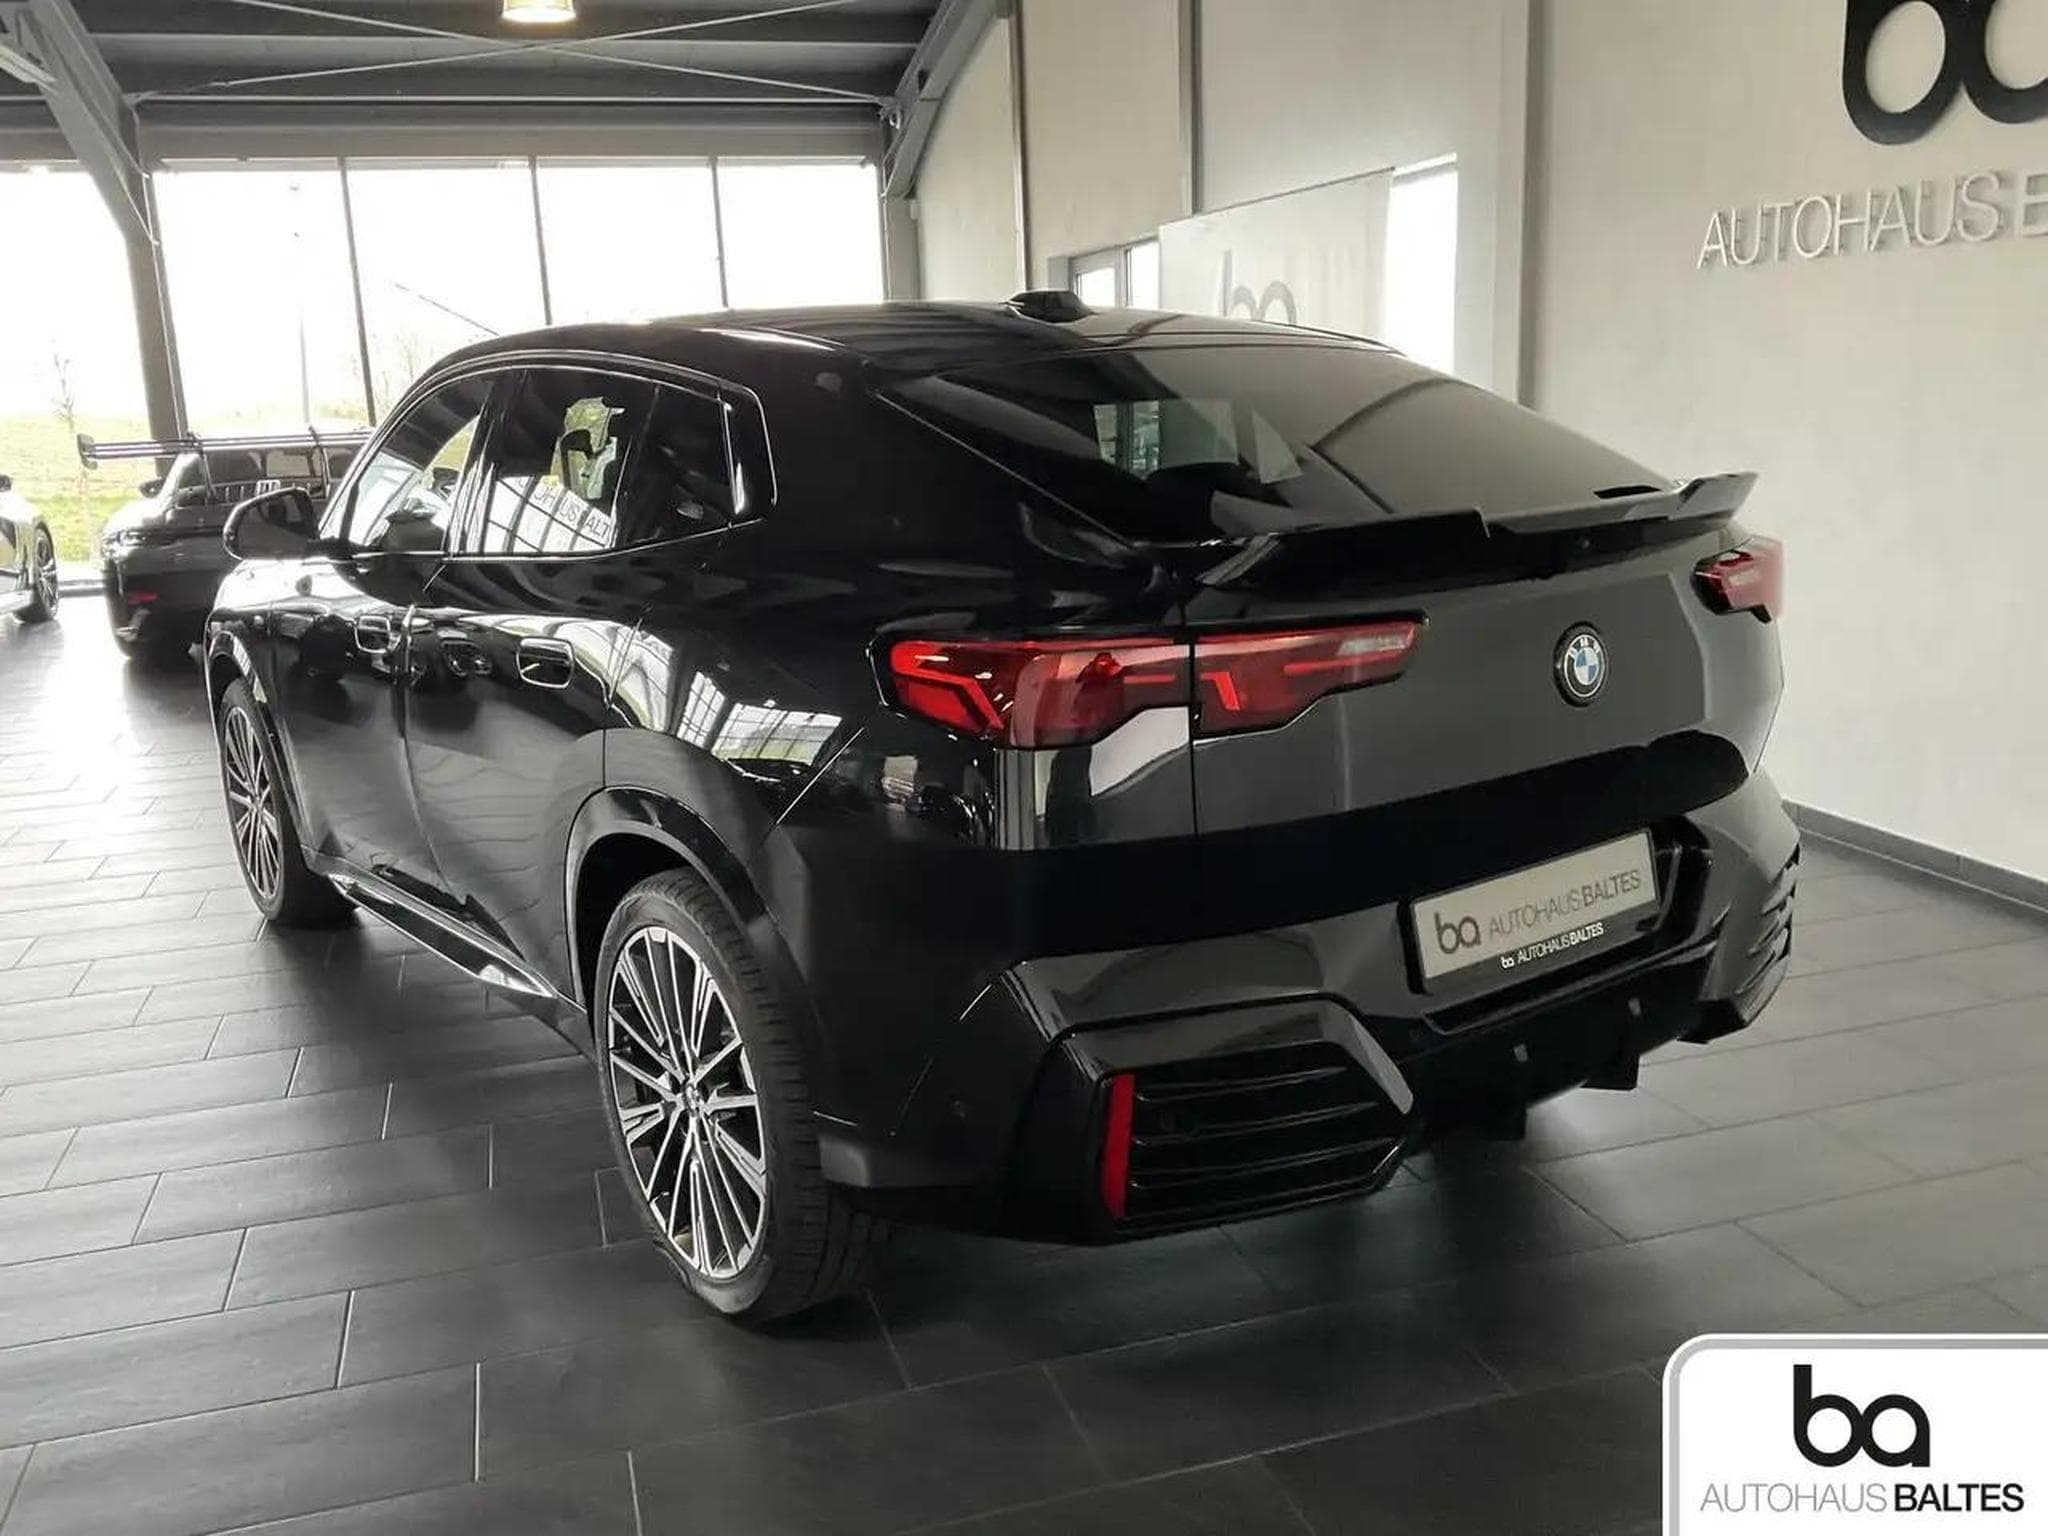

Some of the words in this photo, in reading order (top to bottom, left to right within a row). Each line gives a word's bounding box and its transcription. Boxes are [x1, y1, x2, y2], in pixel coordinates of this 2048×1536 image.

[1697, 172, 2003, 269] AUTOHAUS
[1434, 913, 1481, 954] ba
[1488, 889, 1582, 940] AUTOHAUS
[1581, 869, 1641, 906] BALTES
[1500, 955, 1516, 969] ba
[1517, 934, 1571, 964] AUTOHAUS
[1569, 922, 1604, 945] BALTES
